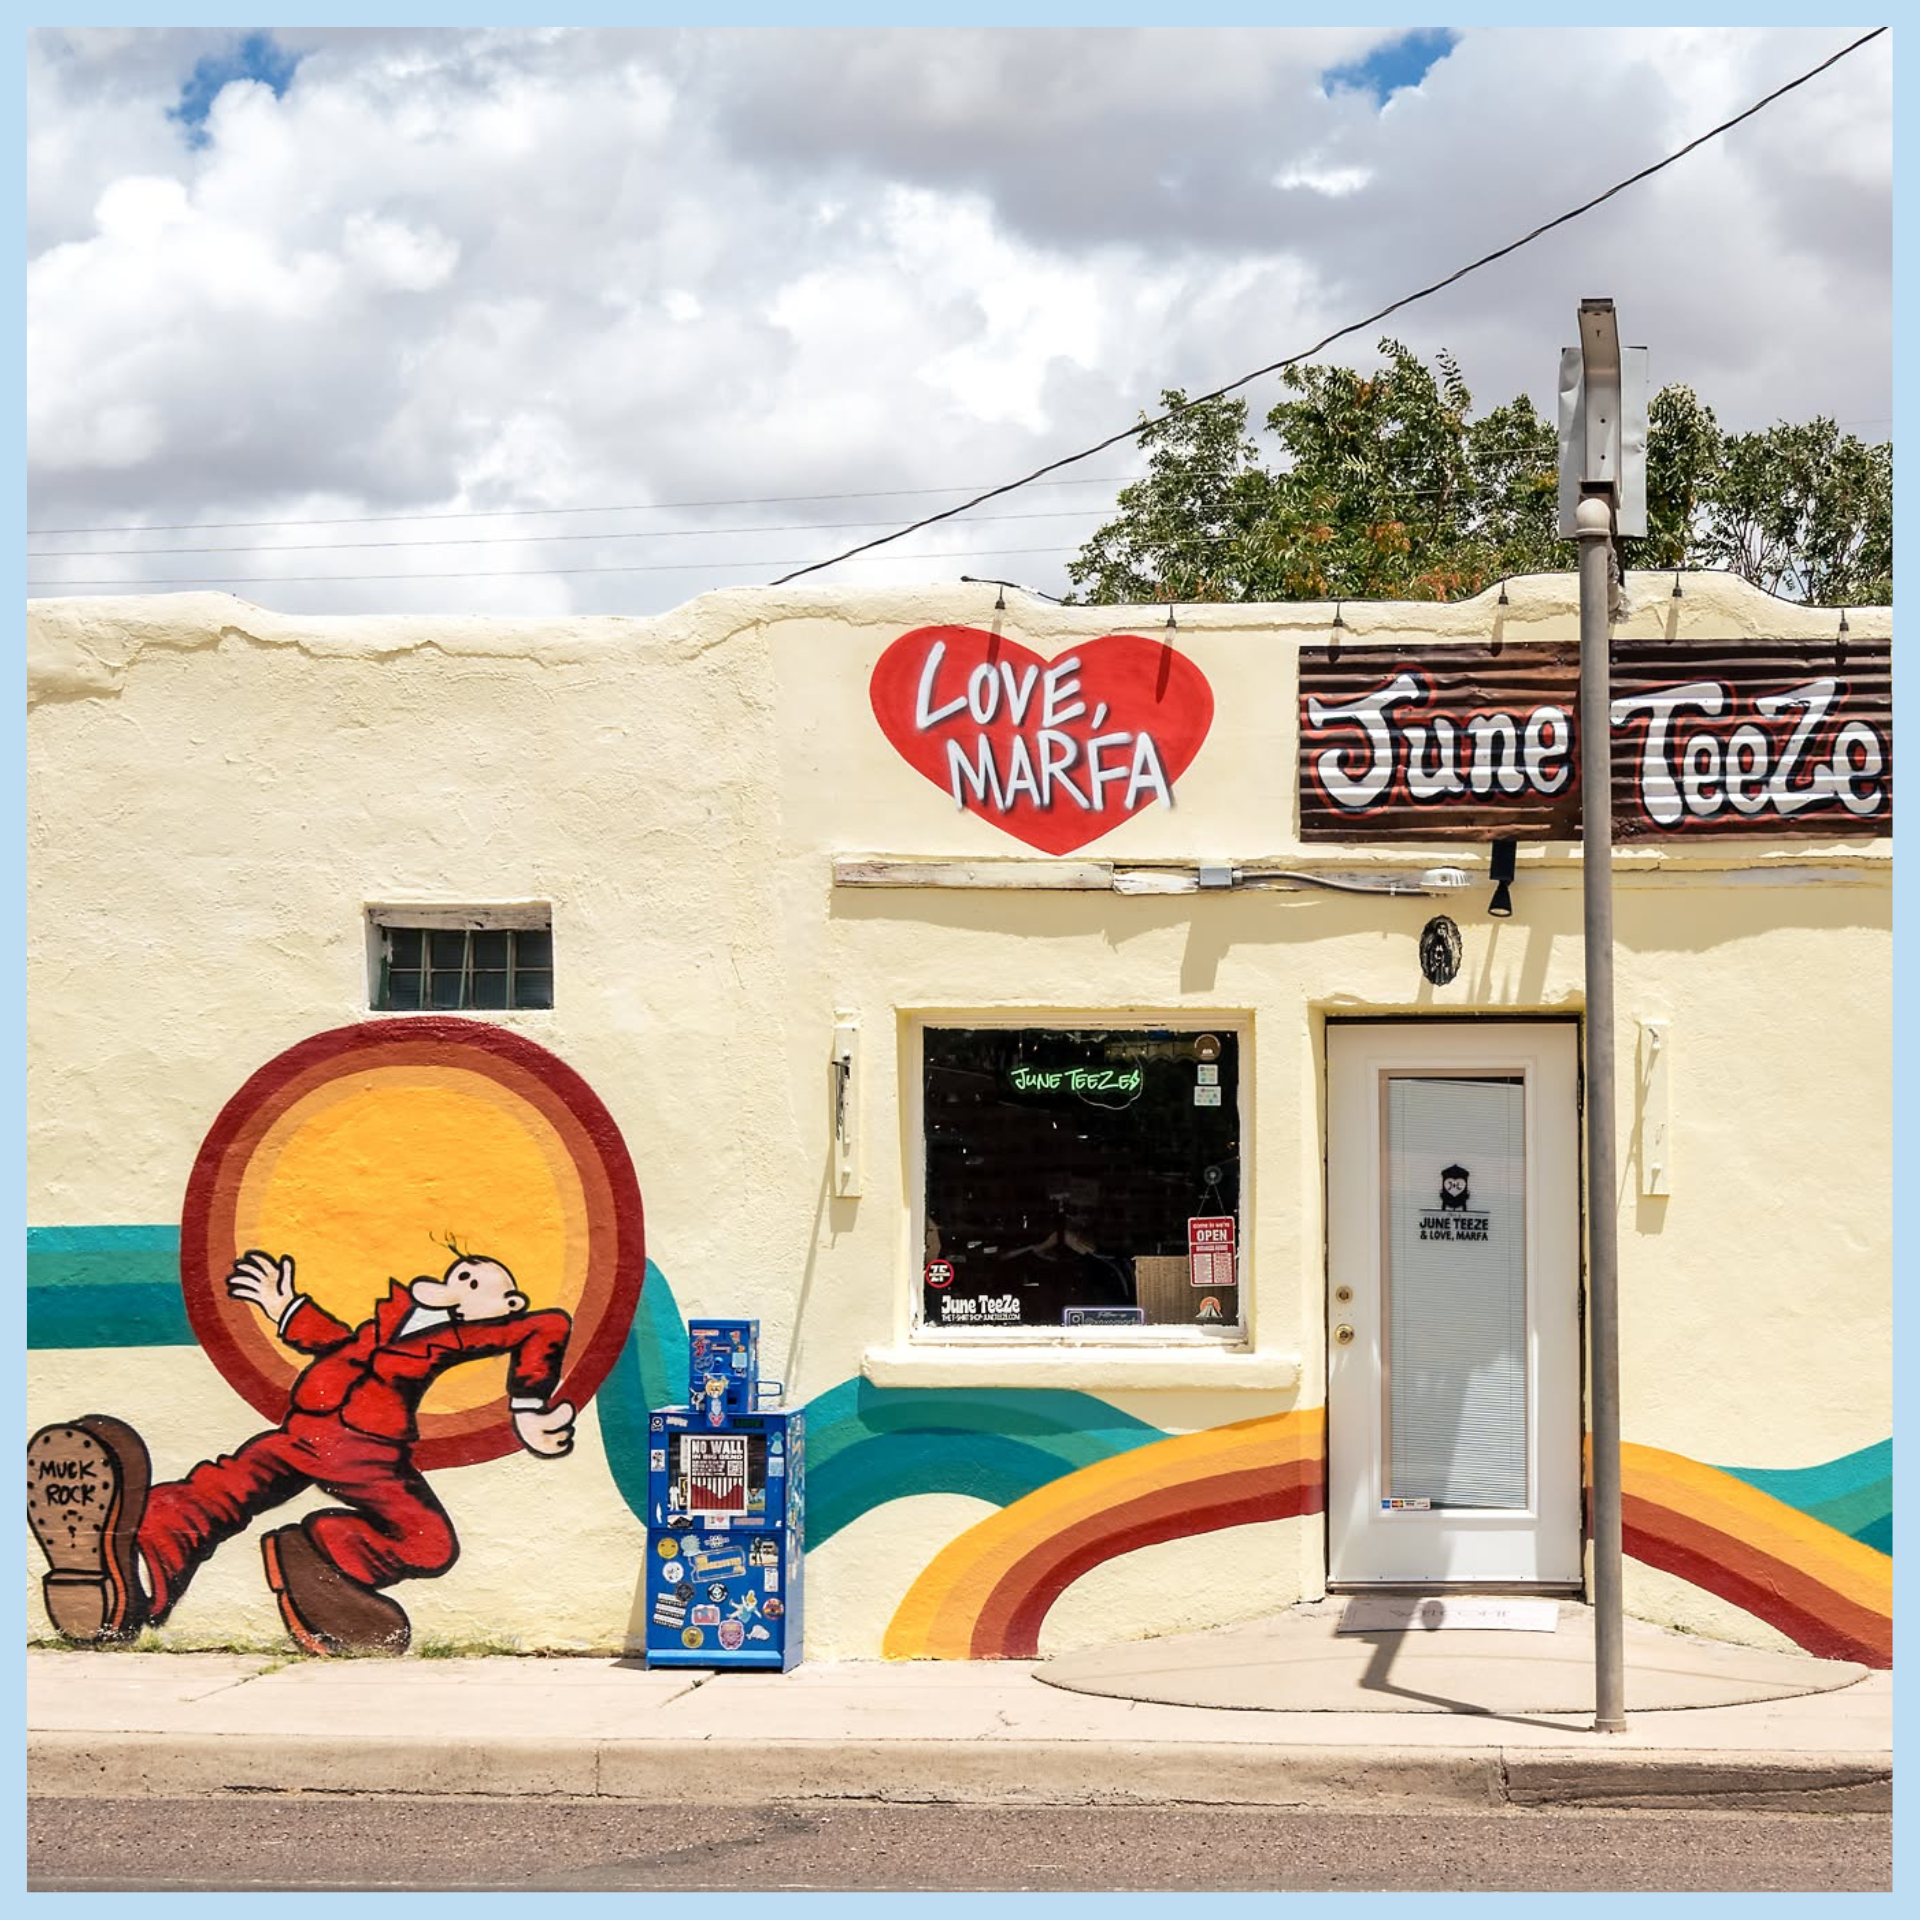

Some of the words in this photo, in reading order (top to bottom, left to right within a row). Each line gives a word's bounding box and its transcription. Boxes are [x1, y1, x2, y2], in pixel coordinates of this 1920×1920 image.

[915, 640, 1109, 730] LOVE,
[1306, 670, 1576, 812] June
[1610, 677, 1888, 828] TeeZe
[946, 728, 1173, 812] MARFA
[1010, 1067, 1063, 1090] JUNE
[1419, 1217, 1451, 1230] JUNE
[1453, 1218, 1489, 1231] TEEZE
[1197, 1229, 1227, 1242] OPEN
[1420, 1230, 1428, 1240] &
[1429, 1230, 1455, 1241] LOVE,
[1456, 1231, 1489, 1241] MARFA
[941, 1294, 977, 1314] June
[978, 1294, 1021, 1314] TeeZe
[692, 1440, 707, 1455] NO
[710, 1440, 743, 1455] WALL
[38, 1460, 97, 1480] MUCK
[45, 1483, 96, 1506] ROCK
